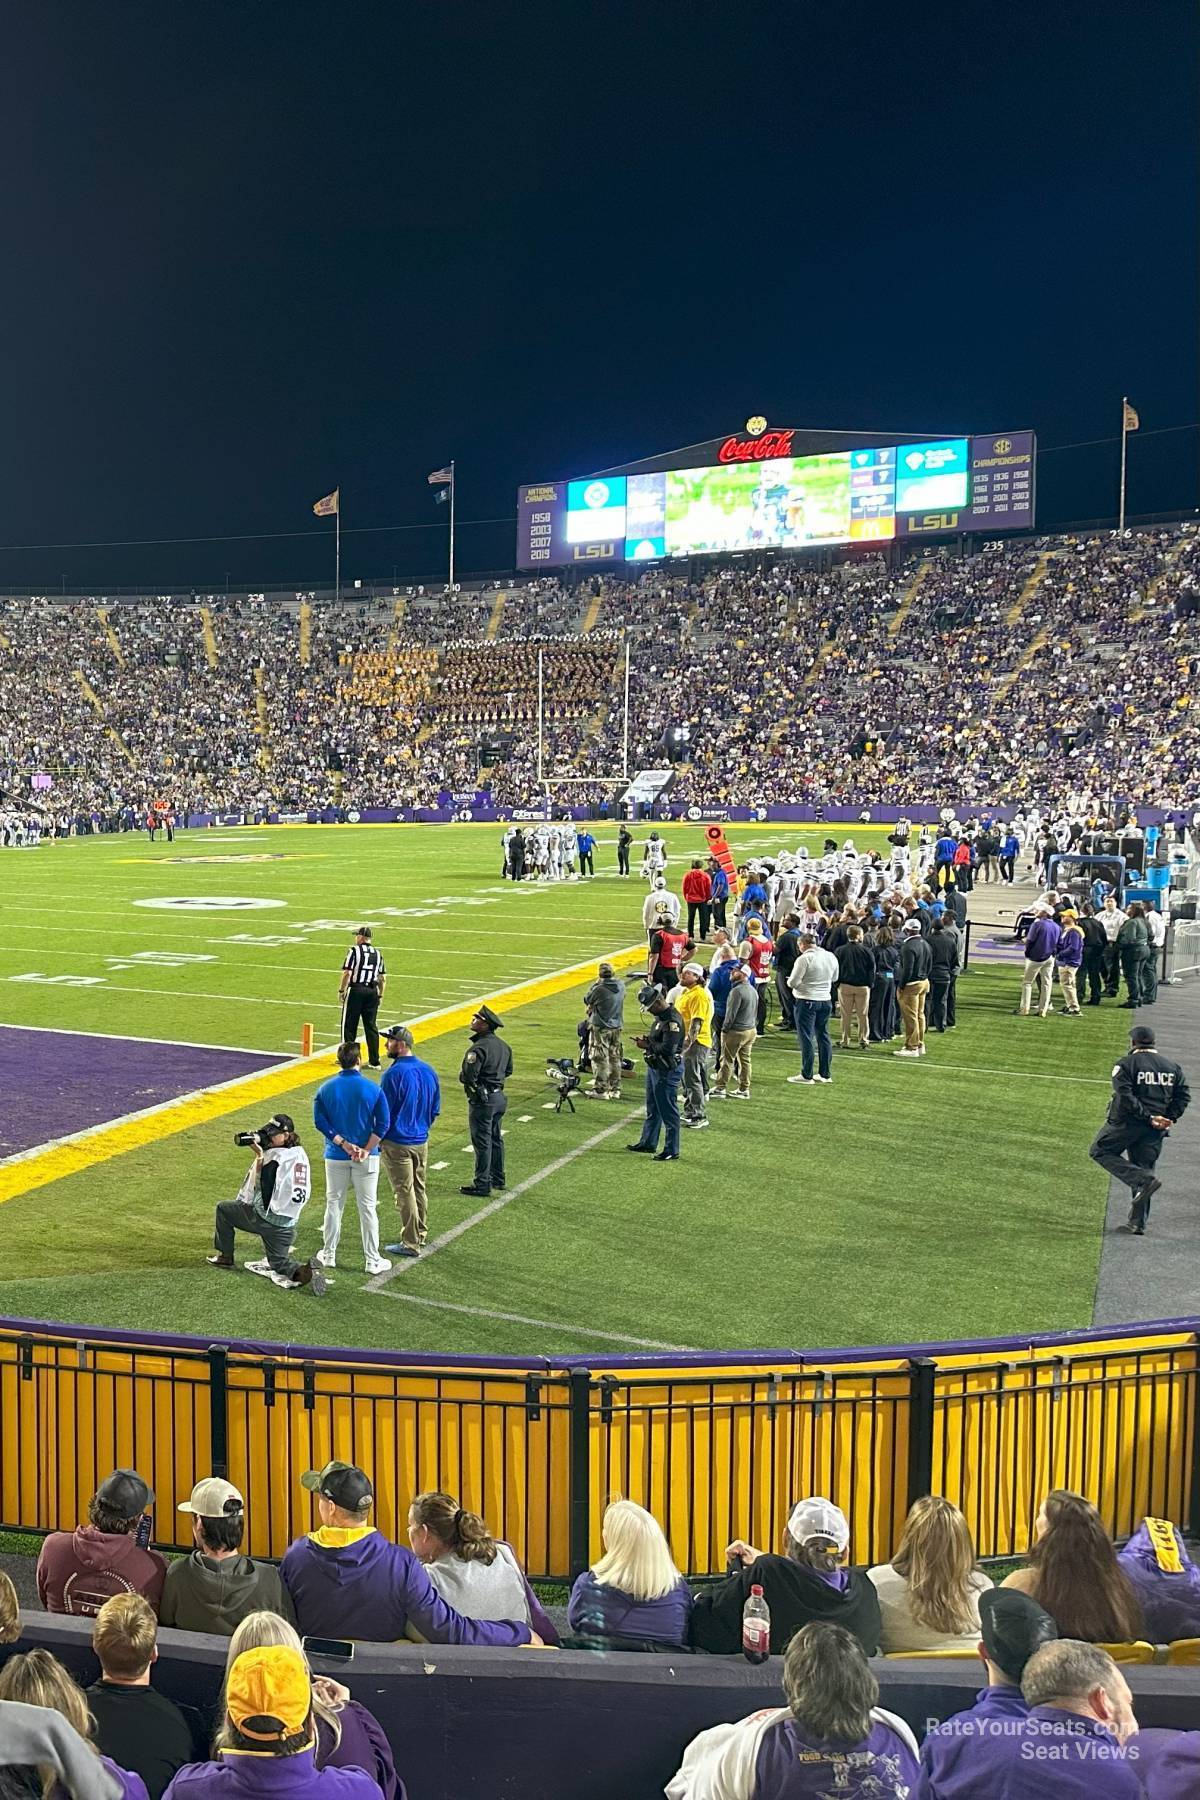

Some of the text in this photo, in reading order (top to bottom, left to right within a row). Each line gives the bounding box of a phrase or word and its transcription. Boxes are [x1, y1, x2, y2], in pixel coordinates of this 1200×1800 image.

[718, 431, 795, 462] Coca-Cola
[994, 440, 1012, 453] SEC
[973, 455, 1031, 468] CHAMPIONSHIPS
[527, 487, 553, 496] NATIONAL
[993, 483, 1008, 491] 1970
[525, 494, 557, 503] CHAMPIONS
[973, 505, 990, 514] 2007
[1013, 502, 1029, 510] 2019
[531, 512, 551, 523] 1958
[908, 513, 958, 532] LSU
[530, 525, 551, 536] 2003
[530, 537, 551, 548] 2007
[982, 541, 1004, 552] 235
[530, 549, 550, 560] 2019
[573, 543, 614, 560] LSU
[362, 953, 374, 969] L
[1136, 1071, 1175, 1086] POLICE
